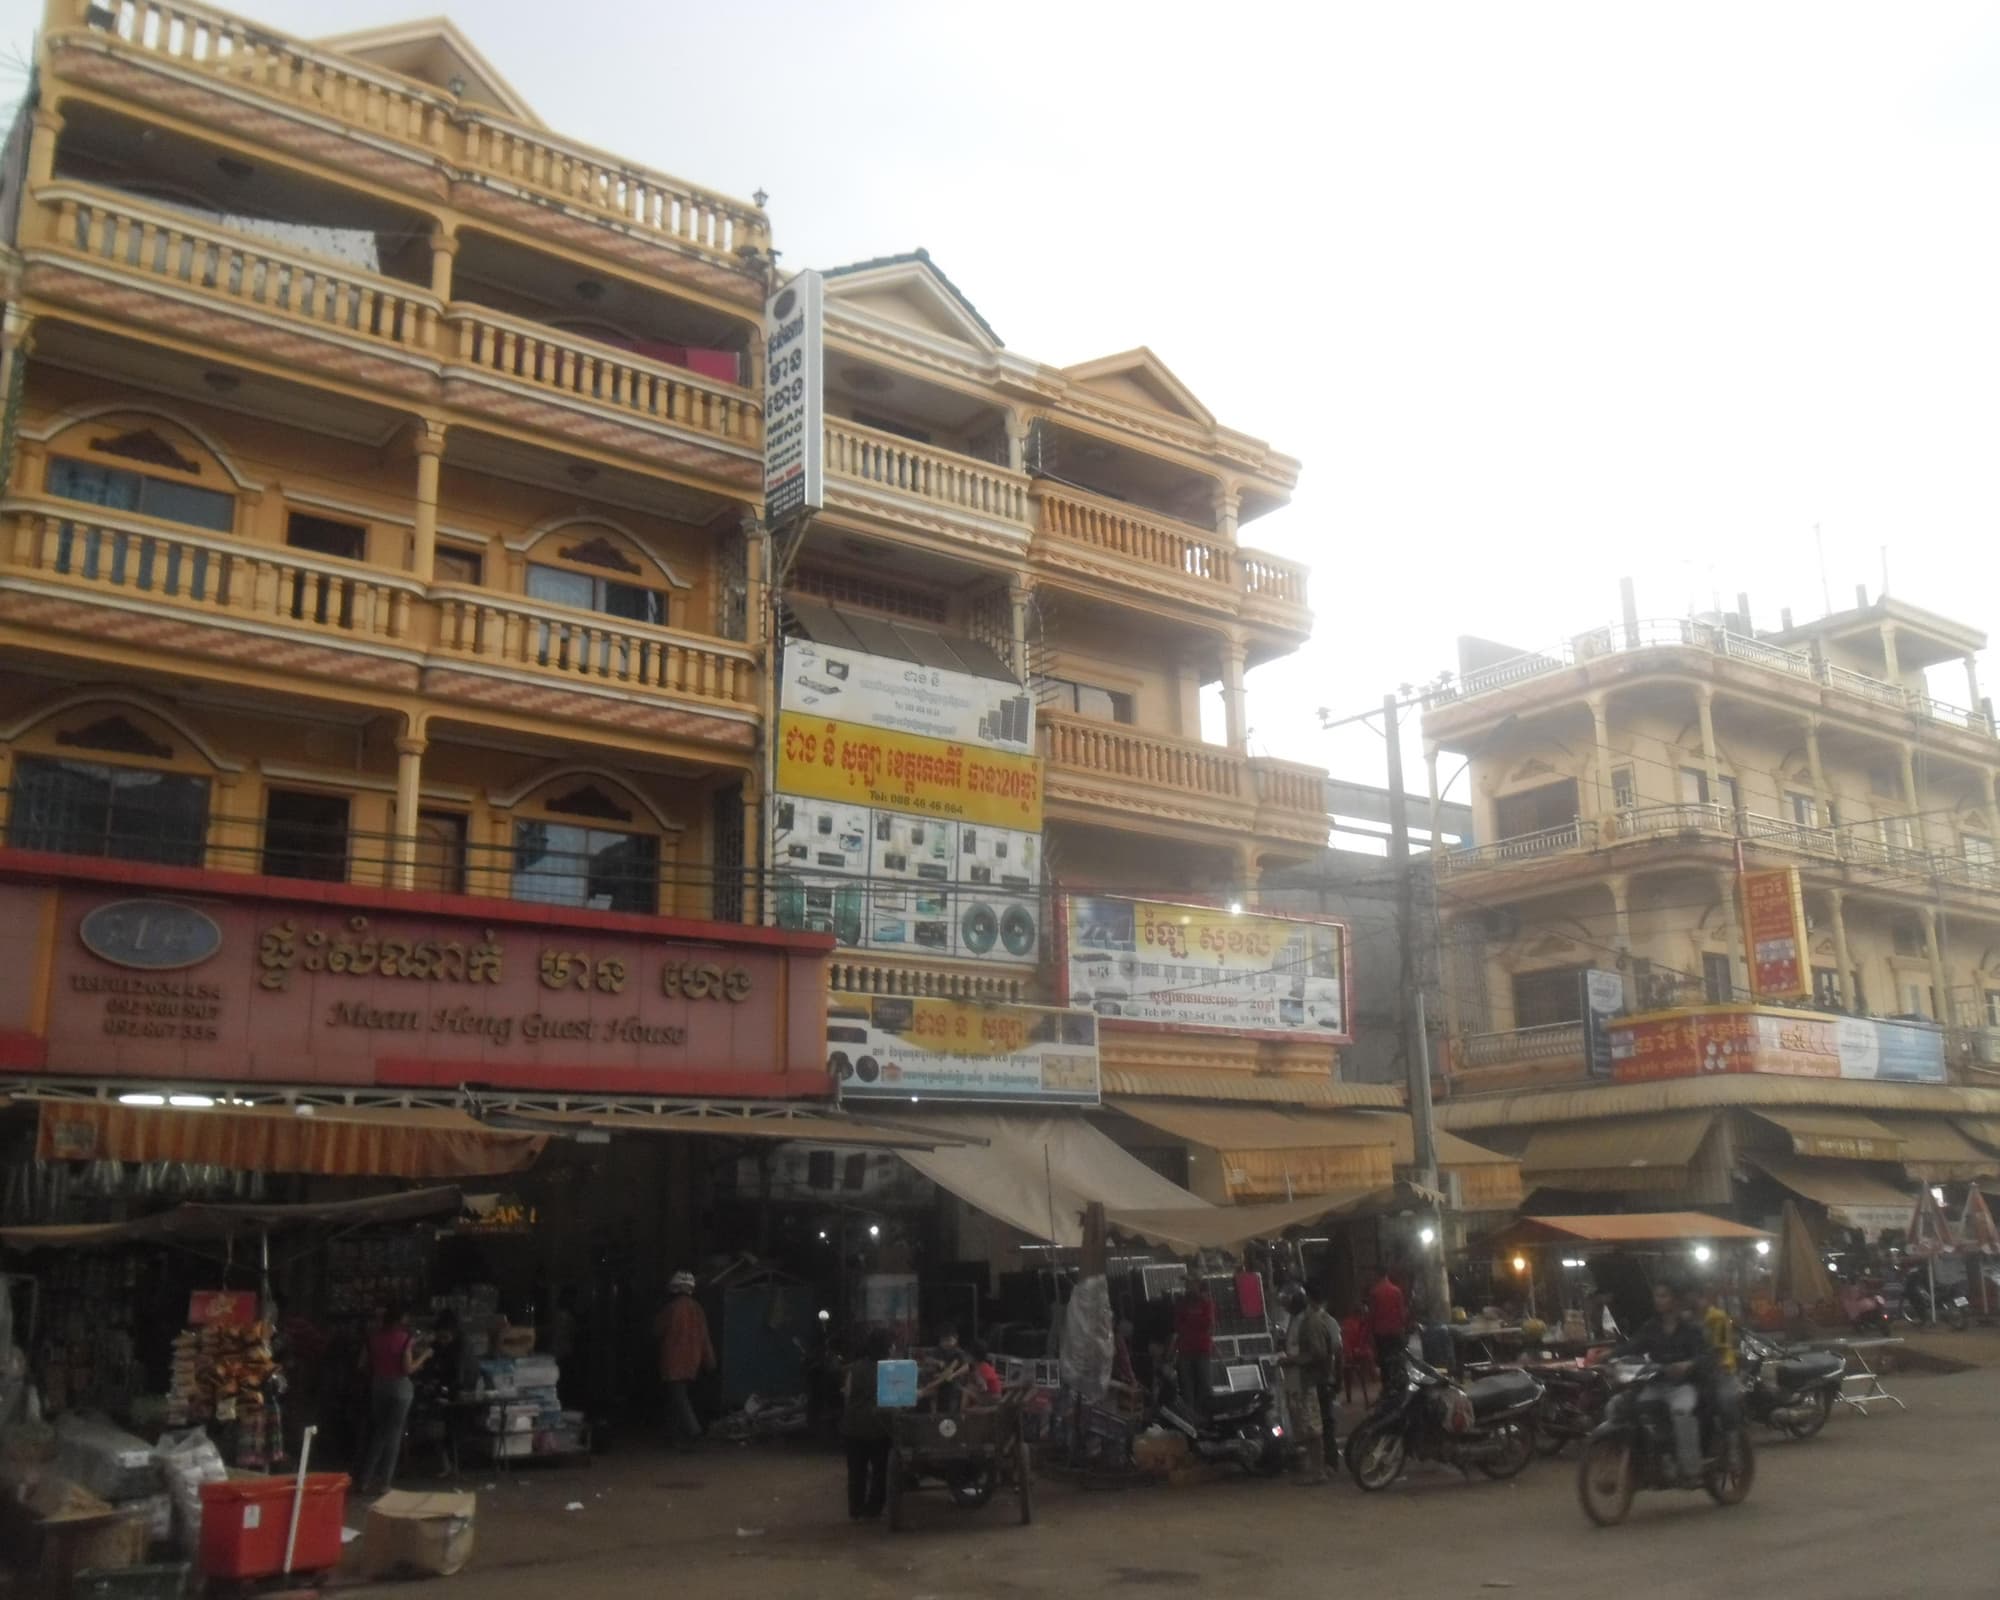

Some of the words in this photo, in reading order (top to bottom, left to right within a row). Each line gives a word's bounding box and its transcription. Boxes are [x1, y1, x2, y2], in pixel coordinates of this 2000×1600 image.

[766, 420, 803, 452] HENG
[767, 404, 804, 436] MEAN
[259, 914, 504, 991] ផ្ទះសំណាក់
[540, 948, 626, 994] មាន
[661, 960, 753, 1003] ហេង
[325, 1001, 419, 1031] Mean
[430, 1005, 513, 1046] Heng
[521, 1013, 593, 1043] Guest
[602, 1016, 687, 1046] House
